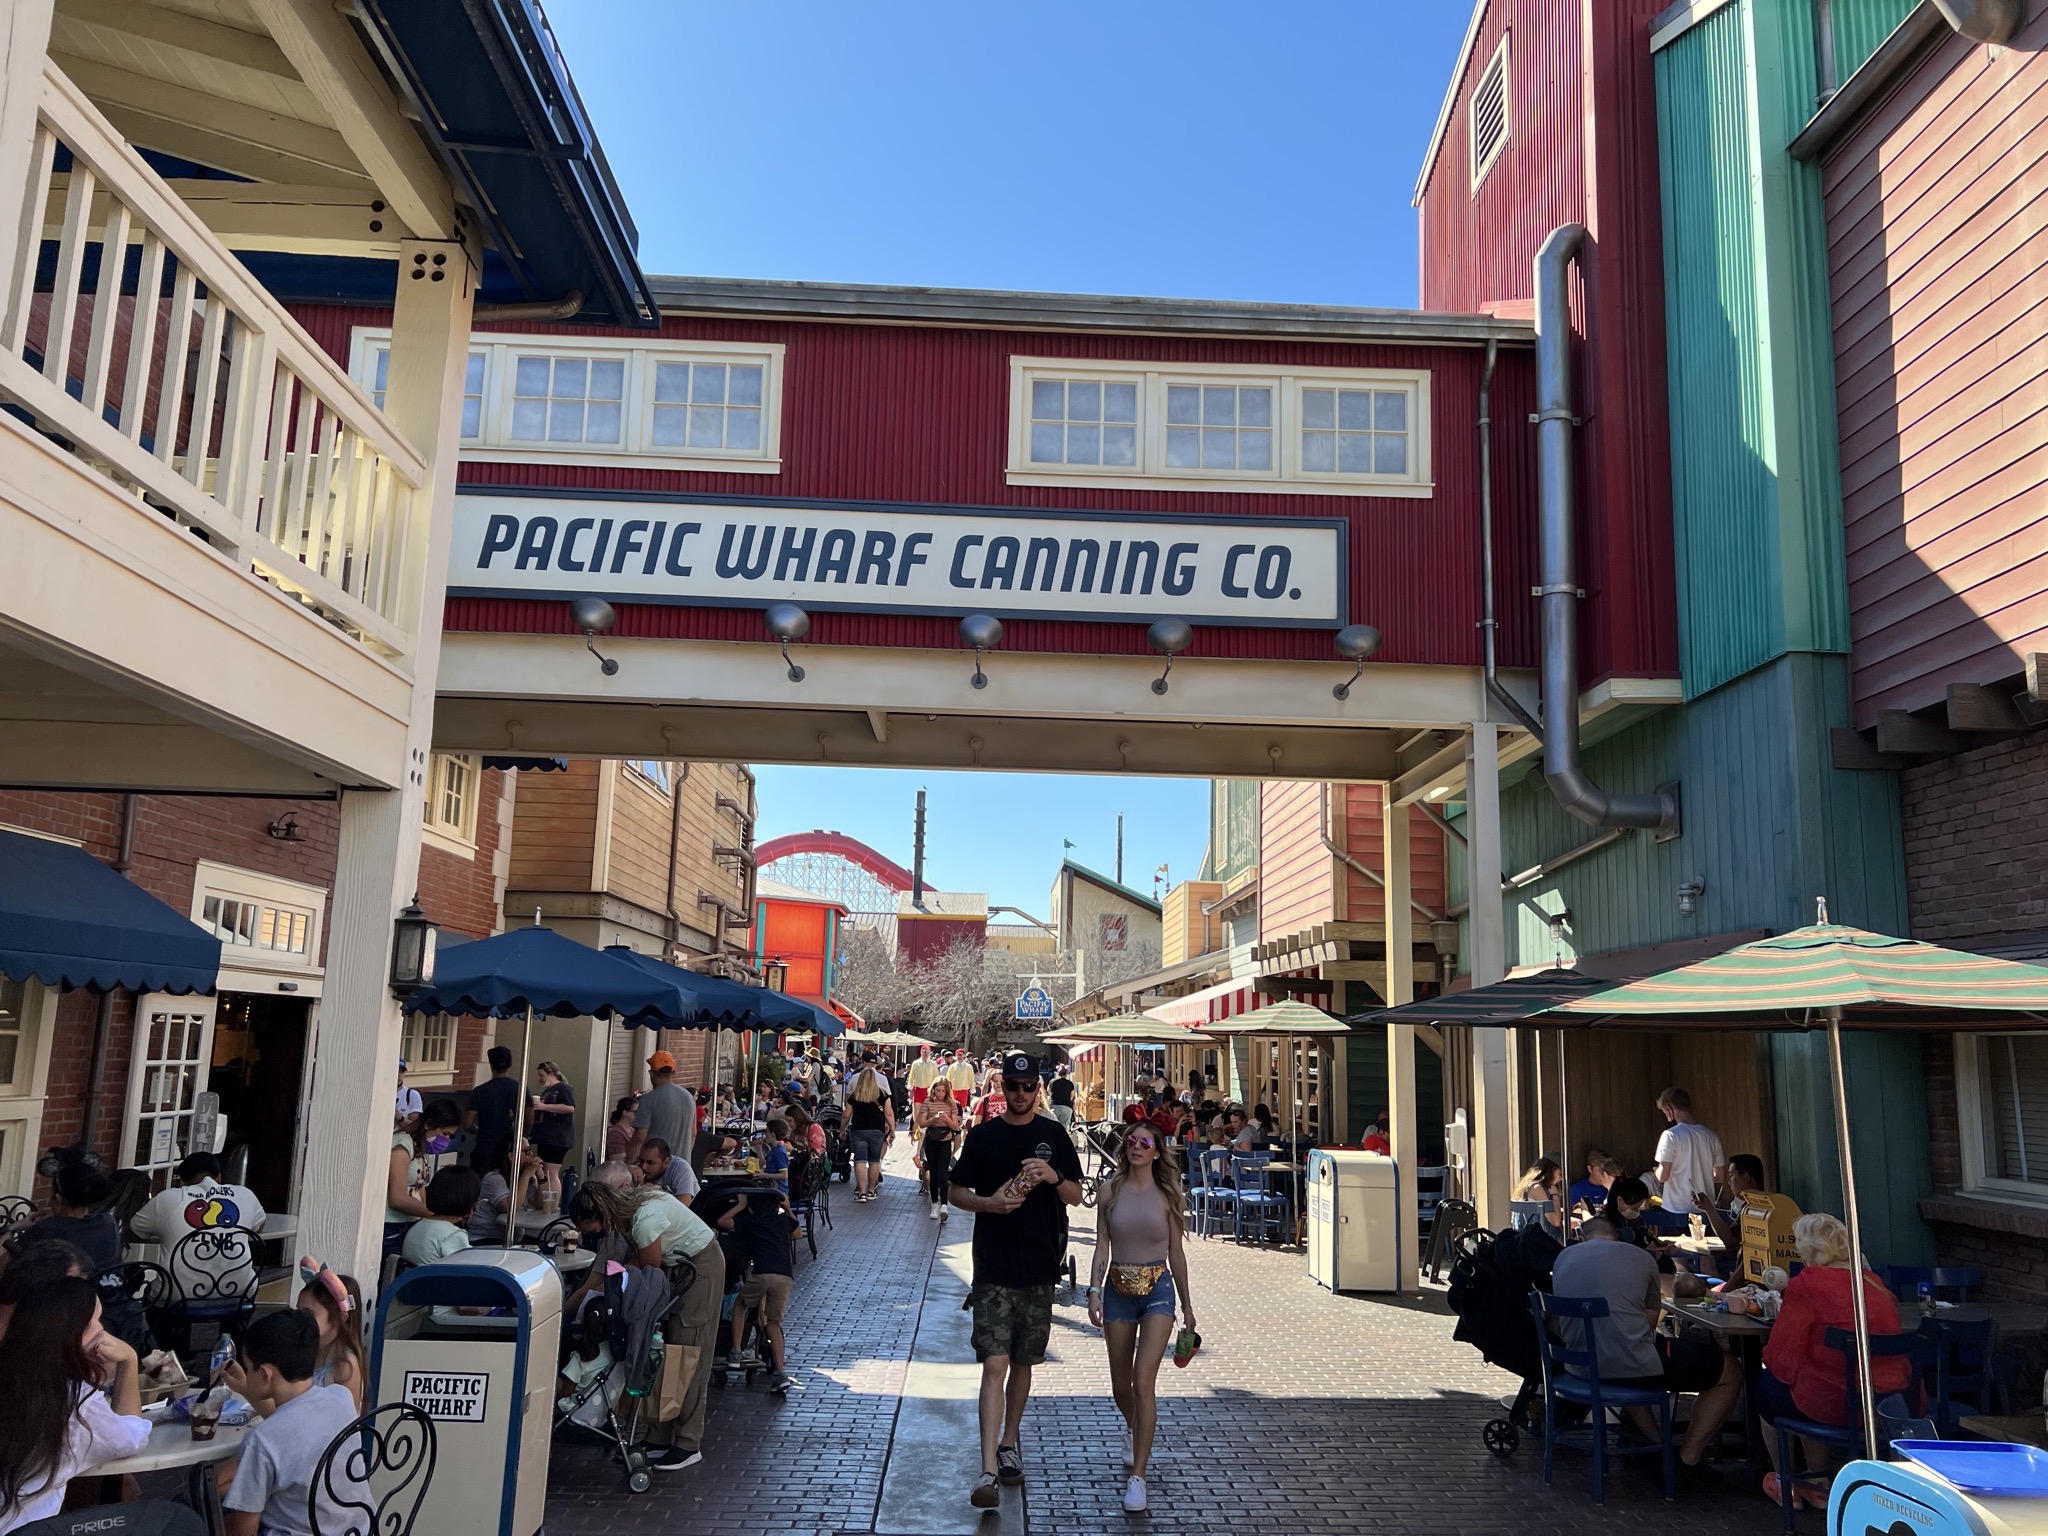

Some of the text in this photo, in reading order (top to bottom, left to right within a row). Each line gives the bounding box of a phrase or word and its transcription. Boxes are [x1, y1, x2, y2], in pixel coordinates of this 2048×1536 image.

[476, 514, 1302, 600] PACIFIC WHARF CANNING CO.
[1019, 999, 1051, 1008] PACIFIC
[1020, 1006, 1050, 1014] WHARF
[1744, 1225, 1767, 1238] LETTERS
[410, 1377, 481, 1396] PACIFIC
[412, 1398, 477, 1417] WHARF
[1873, 1492, 1933, 1528] MIXED RECYCLING
[71, 1515, 126, 1535] PRIDE
